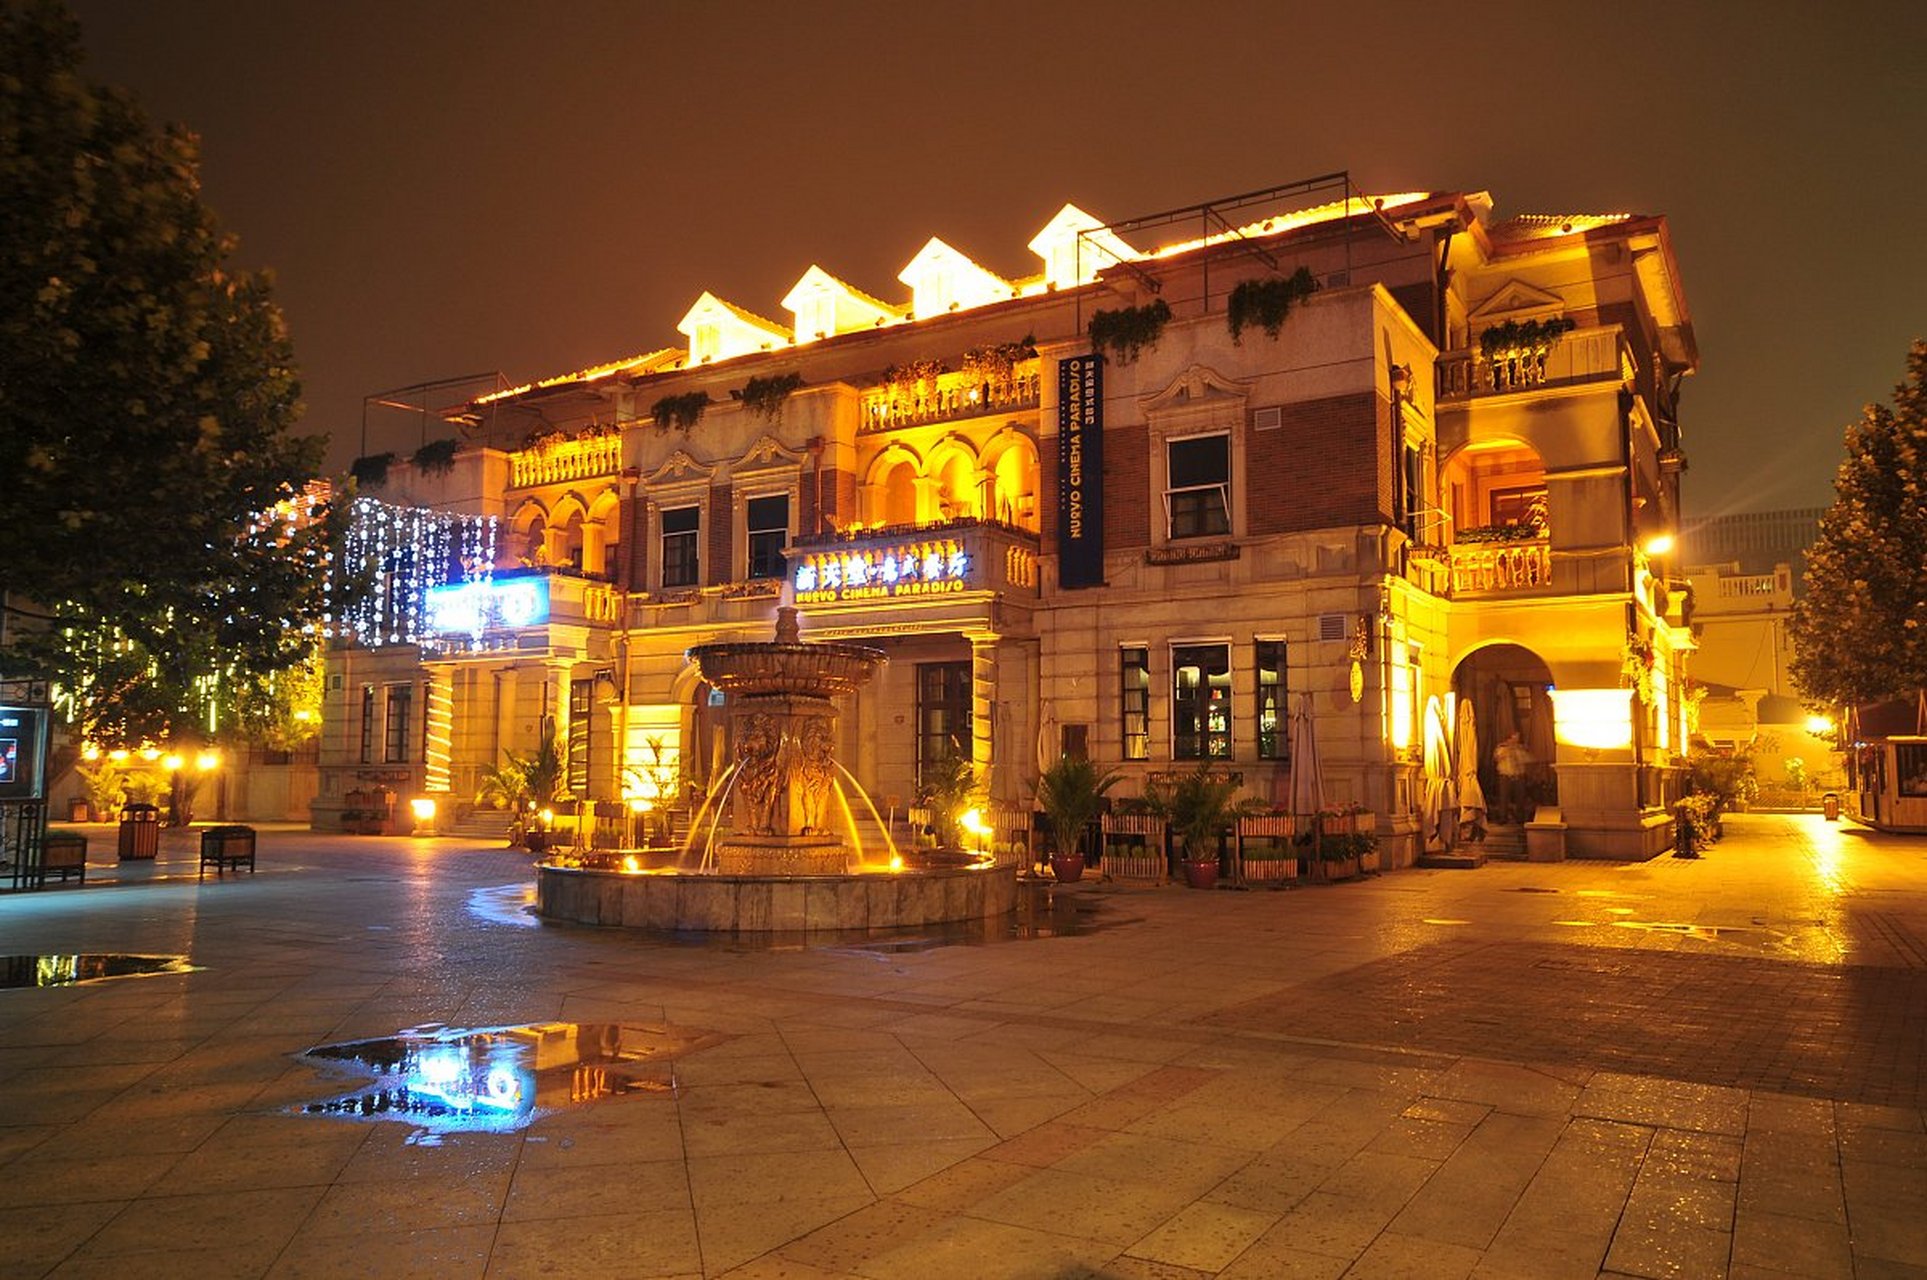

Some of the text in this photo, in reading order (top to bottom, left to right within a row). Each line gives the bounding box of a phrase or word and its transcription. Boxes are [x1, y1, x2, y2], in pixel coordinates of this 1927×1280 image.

[1070, 360, 1081, 432] PARADISO
[1070, 434, 1081, 487] CINEMA
[841, 585, 889, 600] CINEMA
[895, 579, 964, 597] PARADISO
